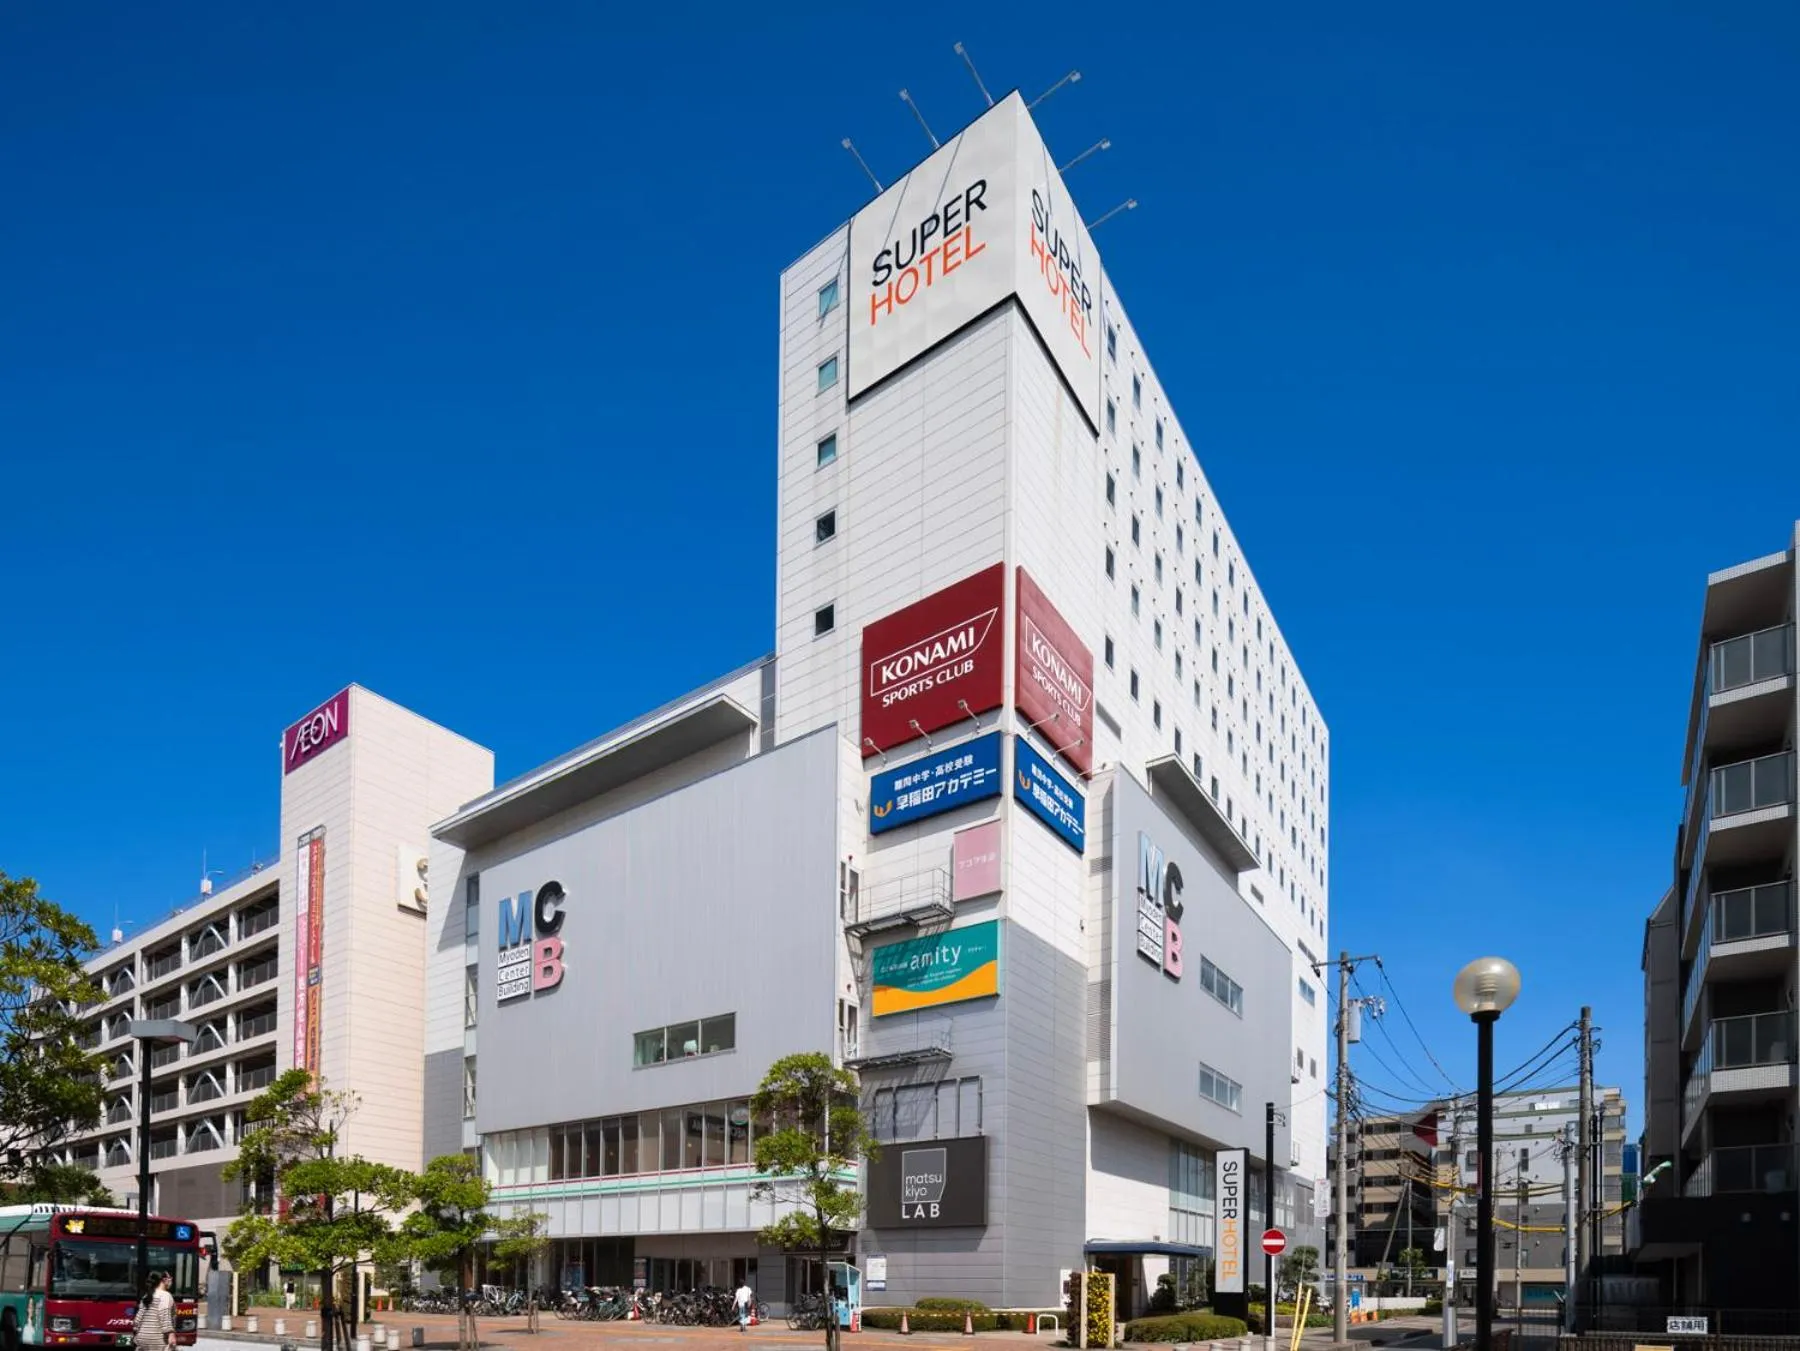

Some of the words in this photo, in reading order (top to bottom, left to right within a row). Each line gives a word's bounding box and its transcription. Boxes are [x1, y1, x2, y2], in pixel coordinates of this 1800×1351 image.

[871, 179, 988, 288] SUPER
[1031, 188, 1092, 325] SUPER
[869, 224, 987, 326] HOTEL
[1030, 222, 1092, 360] HOTEL
[881, 627, 975, 684] KONAMI
[1032, 635, 1082, 705] KONAMI
[882, 678, 933, 707] SPORTS
[936, 659, 974, 685] CLUB
[1032, 665, 1061, 707] SPORTS
[1061, 695, 1081, 726] CLUB
[896, 768, 997, 811] 早稲田アカデミー
[498, 966, 529, 982] Center
[499, 948, 529, 965] Myoden
[910, 945, 961, 970] amity
[498, 980, 529, 997] Building
[905, 1174, 942, 1184] matsu
[905, 1185, 927, 1202] kiyo
[1223, 1161, 1238, 1219] SUPER
[902, 1203, 940, 1219] LAB
[1222, 1219, 1238, 1281] HOTEL
[1669, 1320, 1704, 1331] 店舗用
